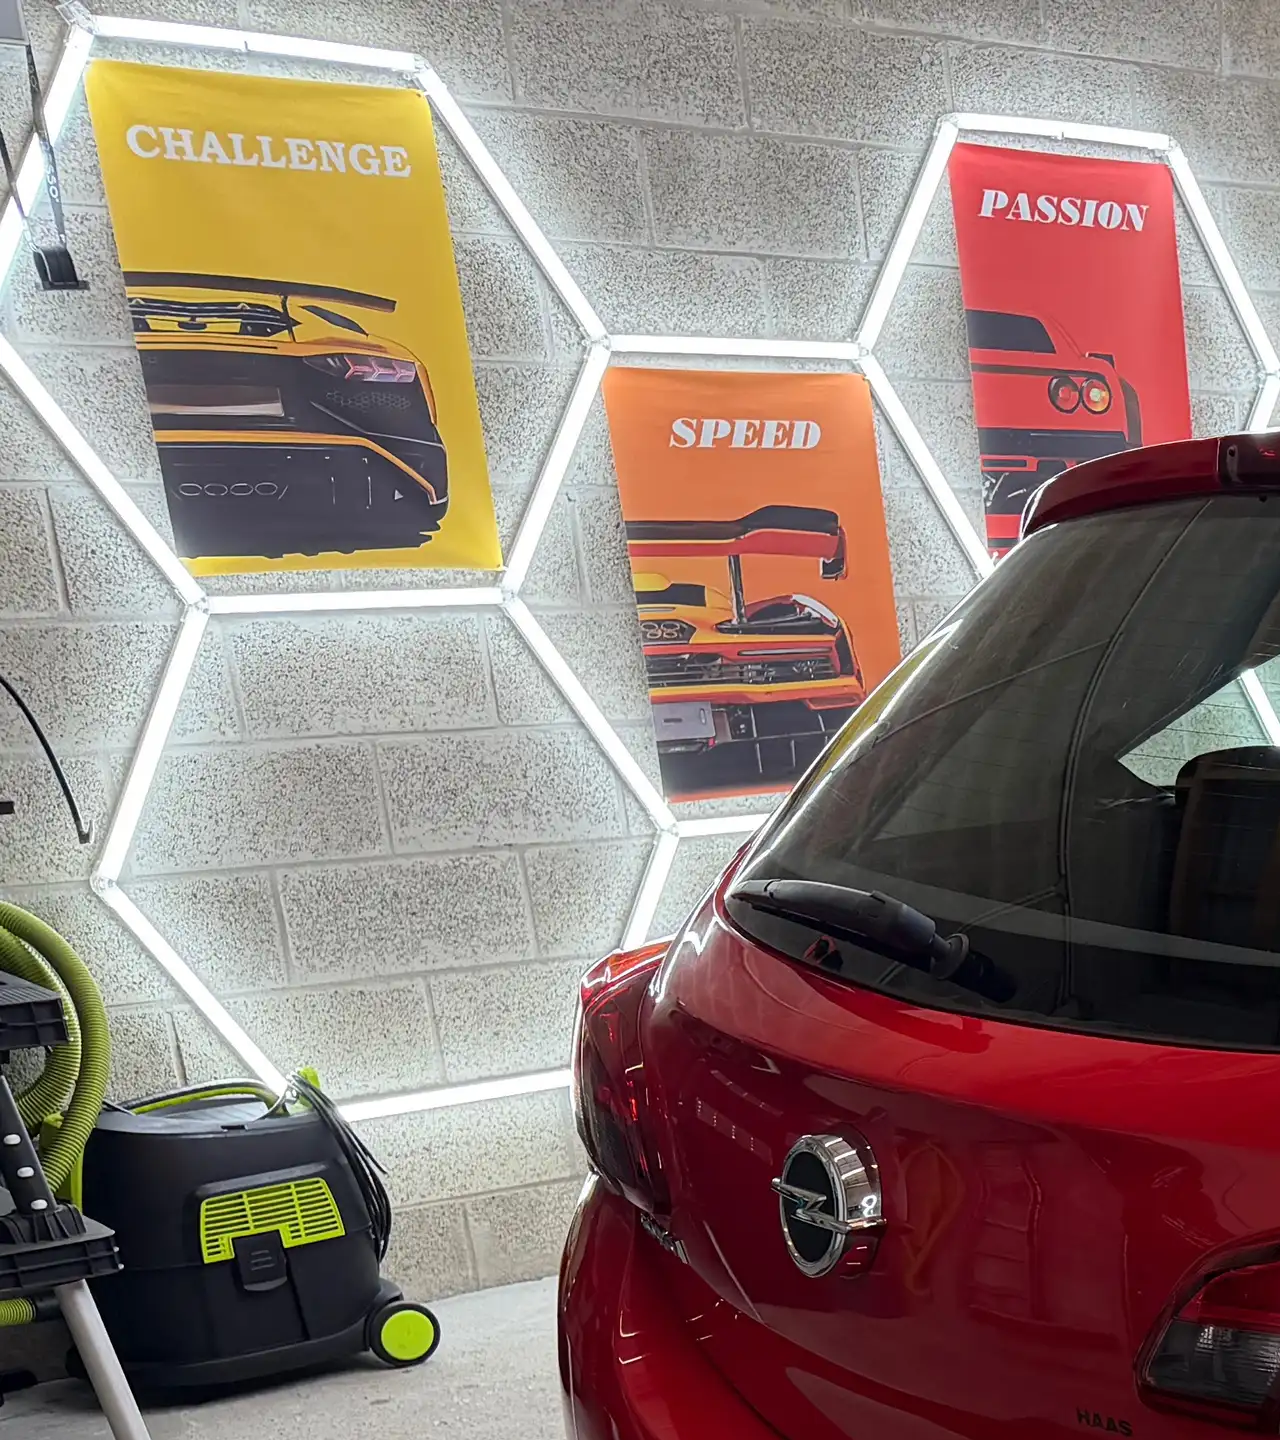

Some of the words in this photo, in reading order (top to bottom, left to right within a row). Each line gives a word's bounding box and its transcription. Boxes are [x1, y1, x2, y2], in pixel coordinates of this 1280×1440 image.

[126, 125, 411, 177] CHALLENGE
[978, 189, 1149, 232] PASSION
[669, 417, 821, 450] SPEED
[1076, 1406, 1133, 1437] HAAS
